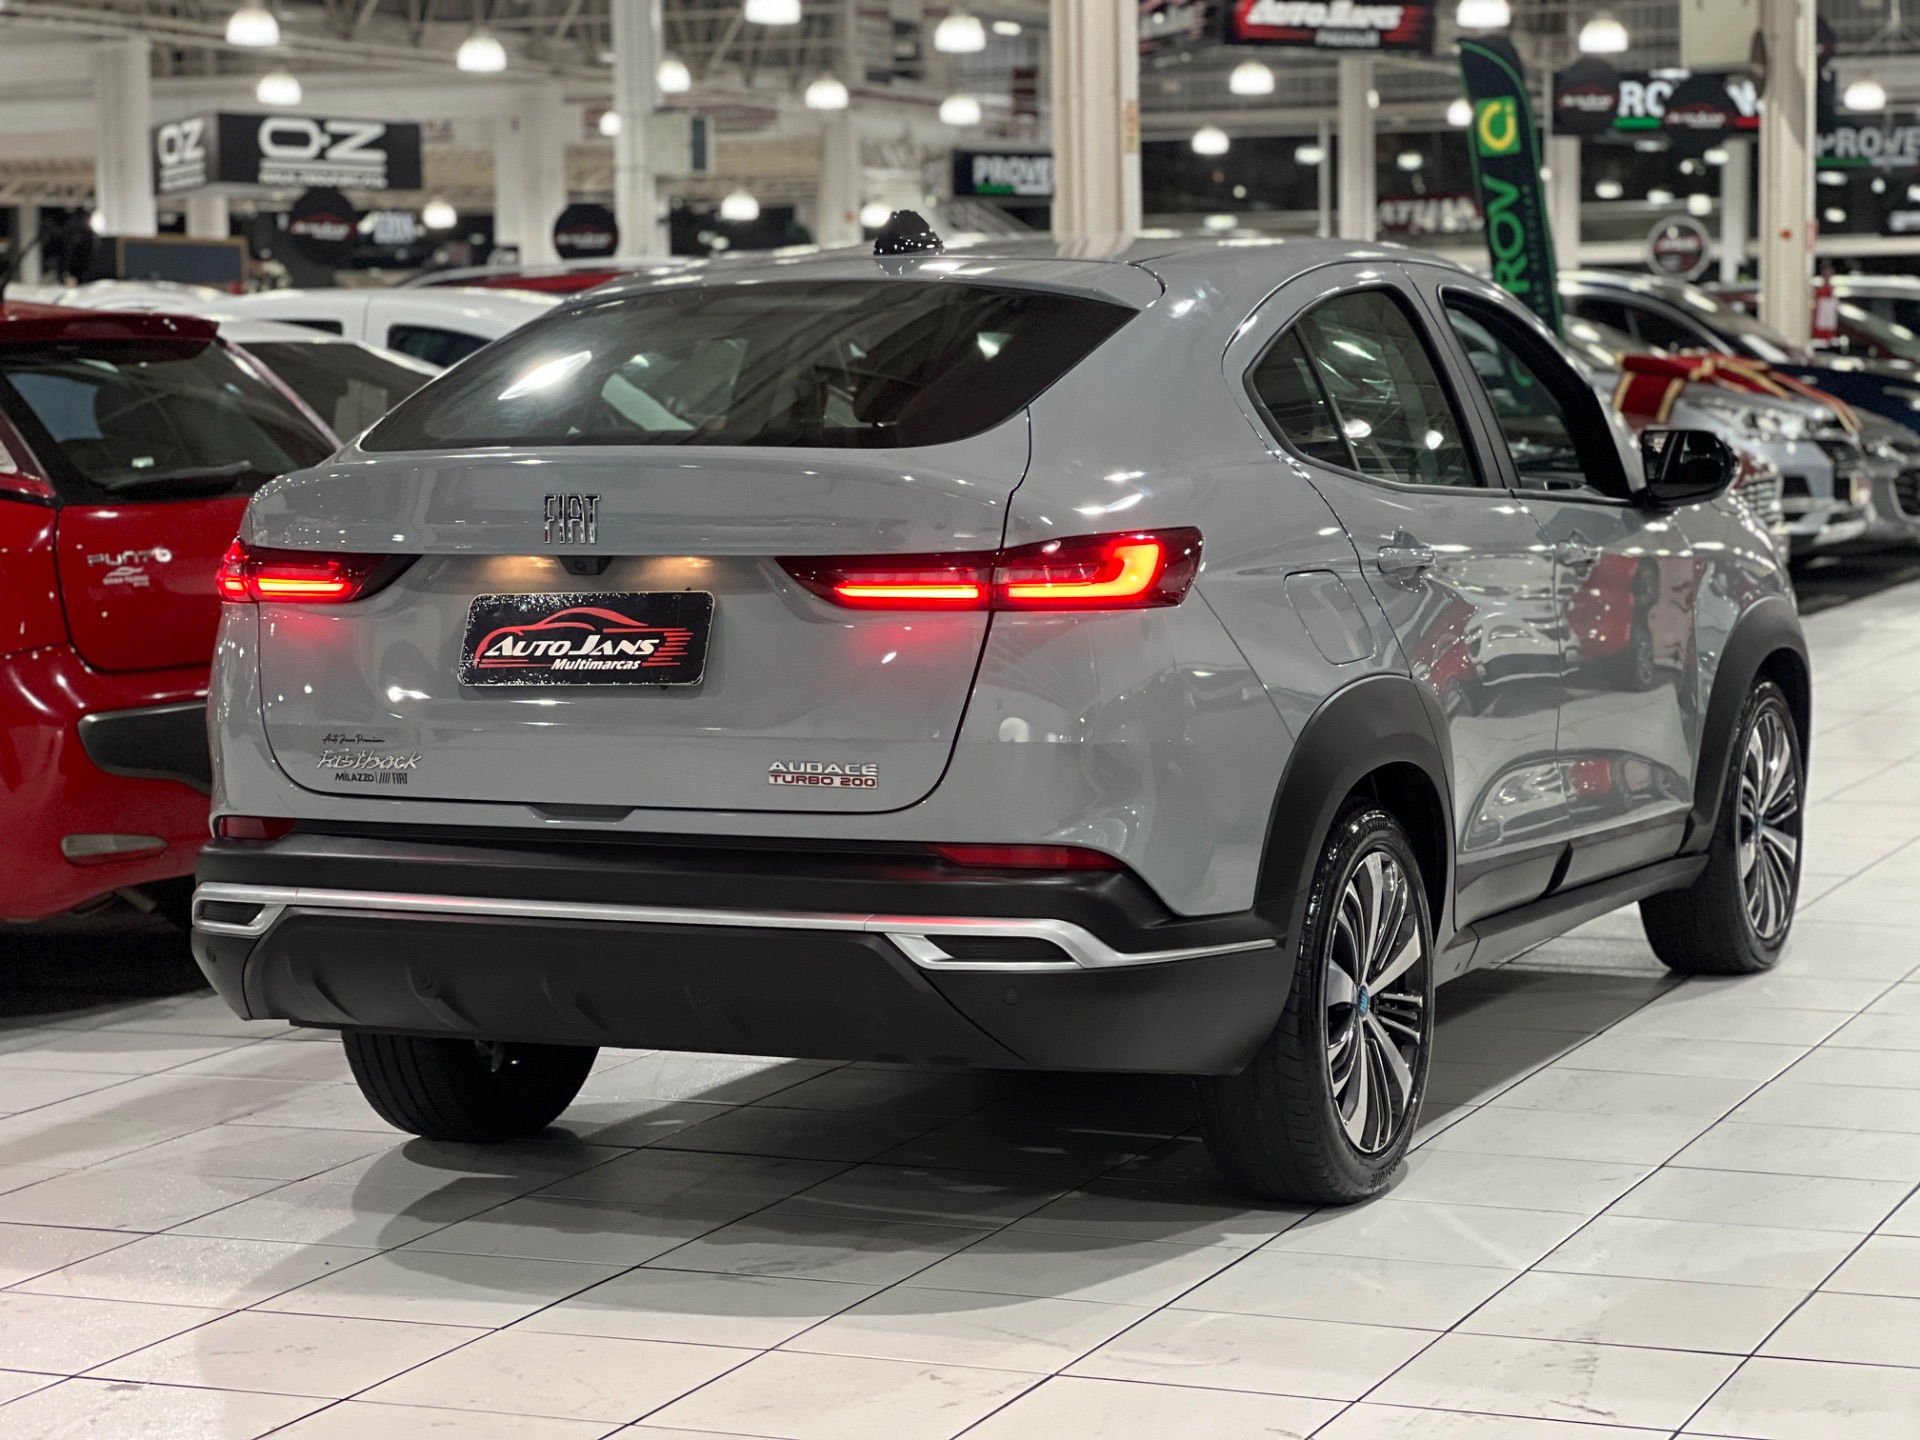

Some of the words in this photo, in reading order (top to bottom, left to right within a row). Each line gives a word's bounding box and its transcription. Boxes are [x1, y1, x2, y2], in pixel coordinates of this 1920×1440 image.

[543, 493, 601, 544] FIAT
[87, 547, 172, 566] PUNTO
[550, 657, 642, 670] Multimarcas
[316, 748, 422, 770] Fastback
[768, 760, 878, 775] AUDACE
[770, 774, 834, 786] TURBO
[839, 777, 876, 788] 200
